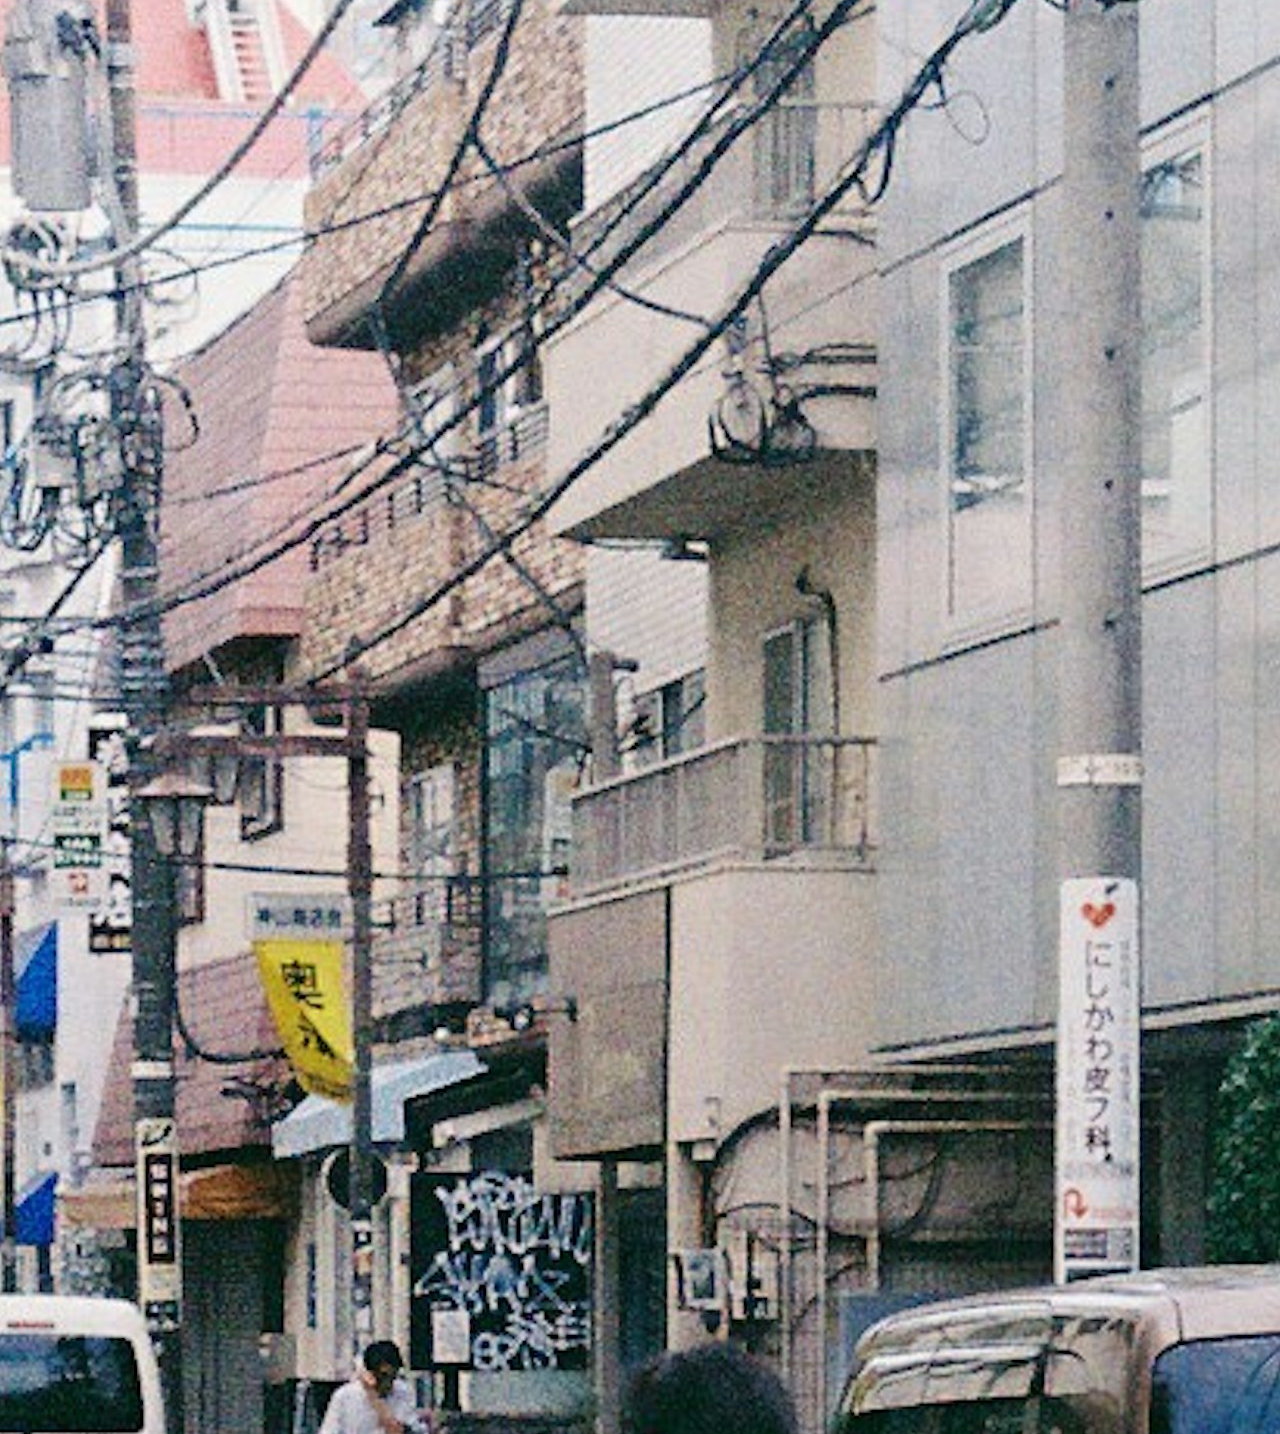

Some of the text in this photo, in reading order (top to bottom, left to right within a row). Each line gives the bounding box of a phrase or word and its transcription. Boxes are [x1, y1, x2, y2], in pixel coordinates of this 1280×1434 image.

[1083, 939, 1115, 1155] にしかわ皮フ科
